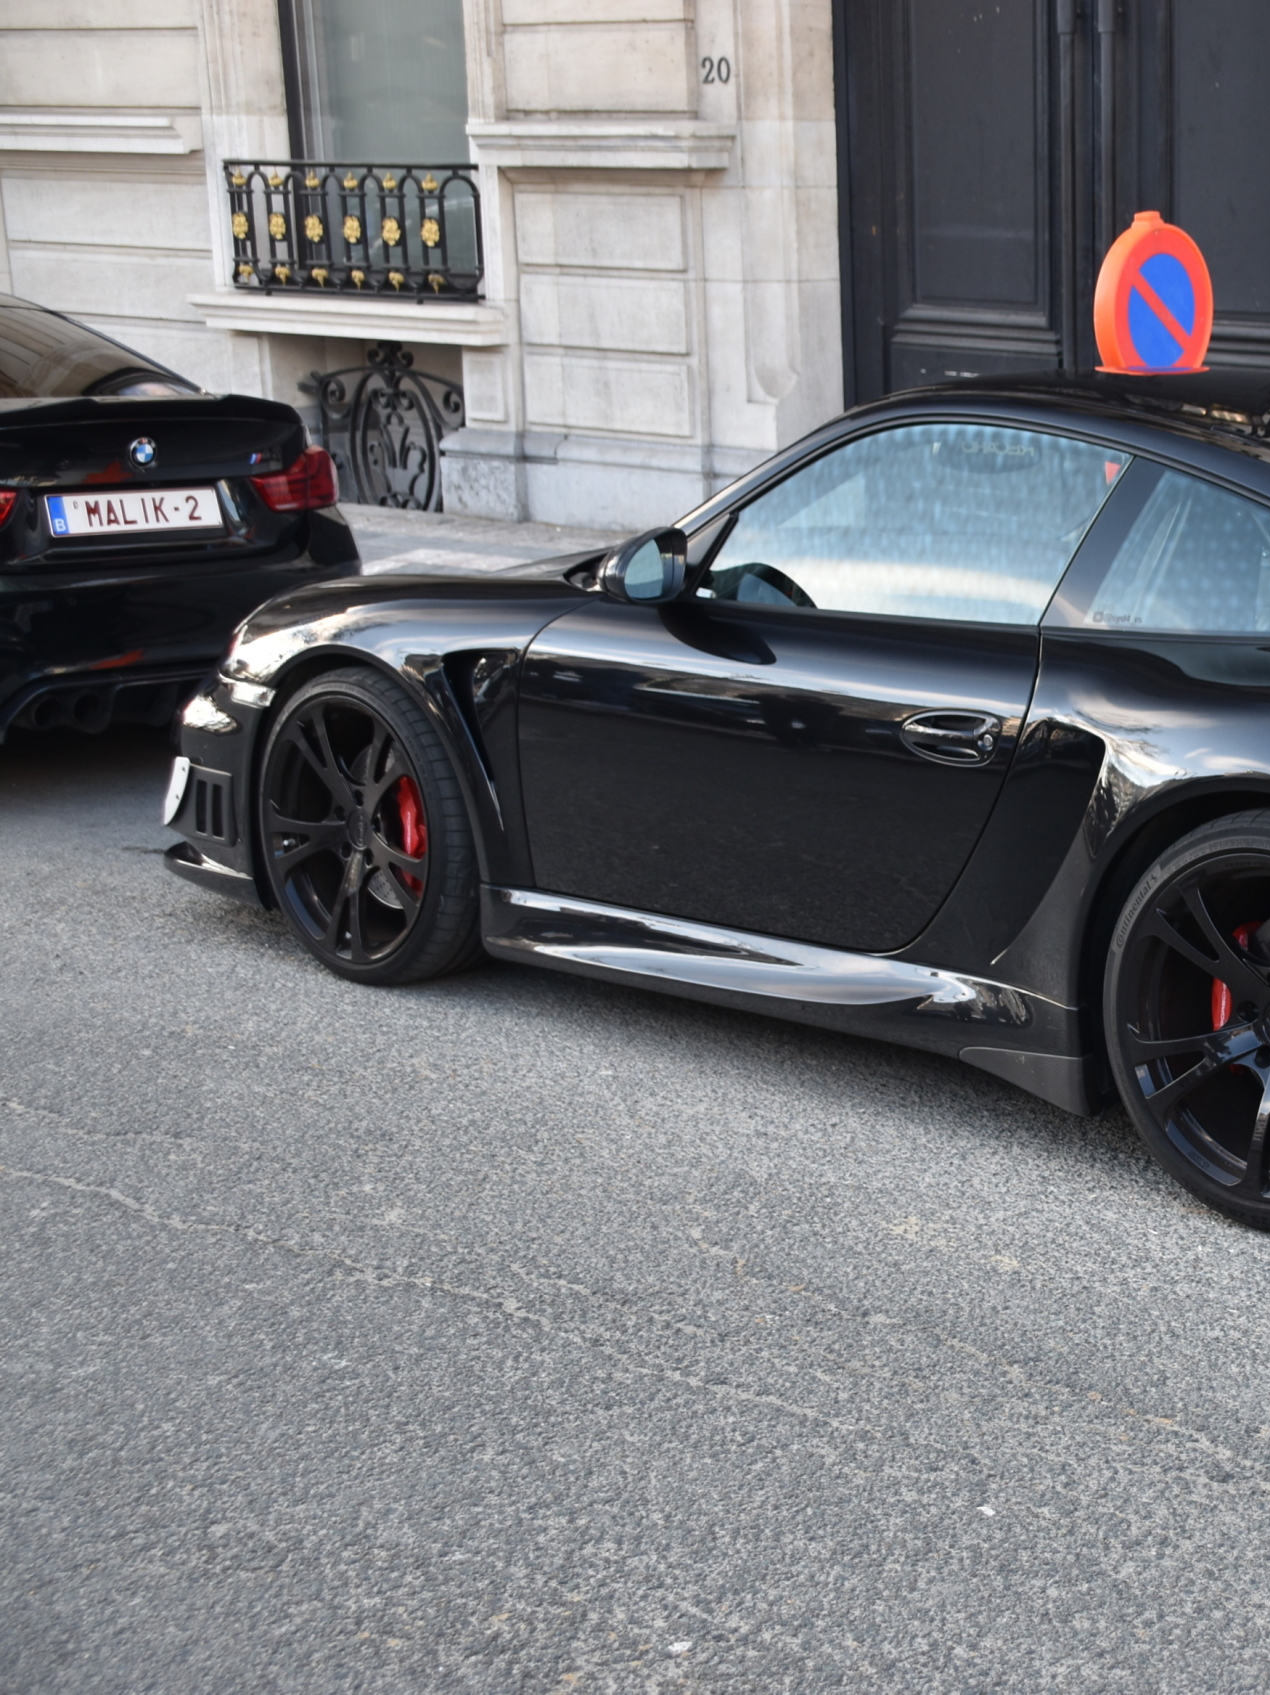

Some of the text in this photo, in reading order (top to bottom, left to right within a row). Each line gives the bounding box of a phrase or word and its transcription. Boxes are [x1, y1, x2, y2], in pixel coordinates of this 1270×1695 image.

[701, 56, 731, 84] 20
[54, 517, 67, 532] B
[1116, 884, 1151, 948] Continental
